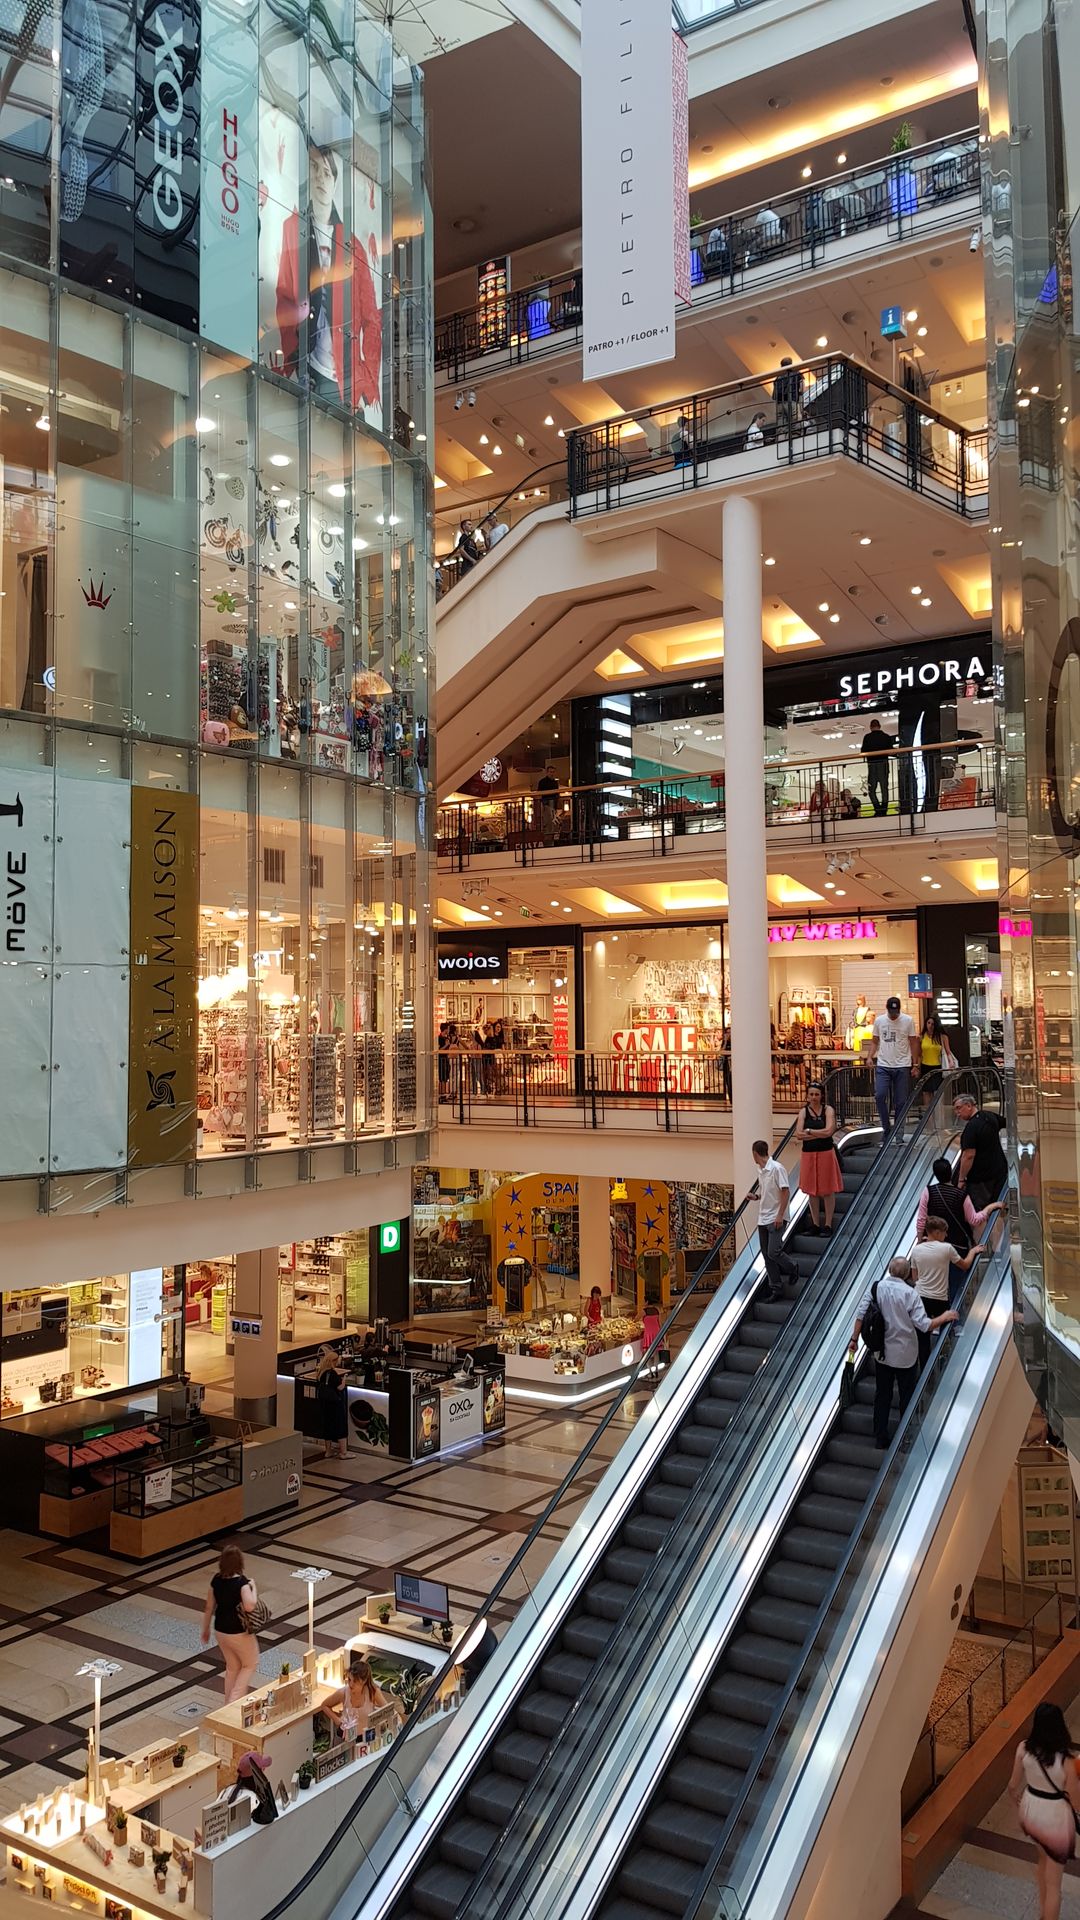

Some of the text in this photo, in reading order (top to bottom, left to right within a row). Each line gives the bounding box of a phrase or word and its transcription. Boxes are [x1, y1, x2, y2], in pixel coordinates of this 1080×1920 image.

[153, 12, 185, 231] GEOX
[220, 107, 240, 215] HUGO
[620, 0, 634, 306] PIETRO FILI
[221, 213, 240, 229] HUGO
[221, 220, 240, 236] BOSS
[588, 340, 614, 354] PATRO
[615, 337, 625, 347] +1
[631, 328, 658, 342] FLOOR
[659, 325, 669, 335] +1
[840, 656, 986, 698] SEPHORA
[153, 806, 177, 965] MAISON
[439, 952, 501, 970] wojas
[640, 1027, 695, 1062] SALE
[382, 1226, 398, 1248] D
[320, 1756, 346, 1777] Blocks
